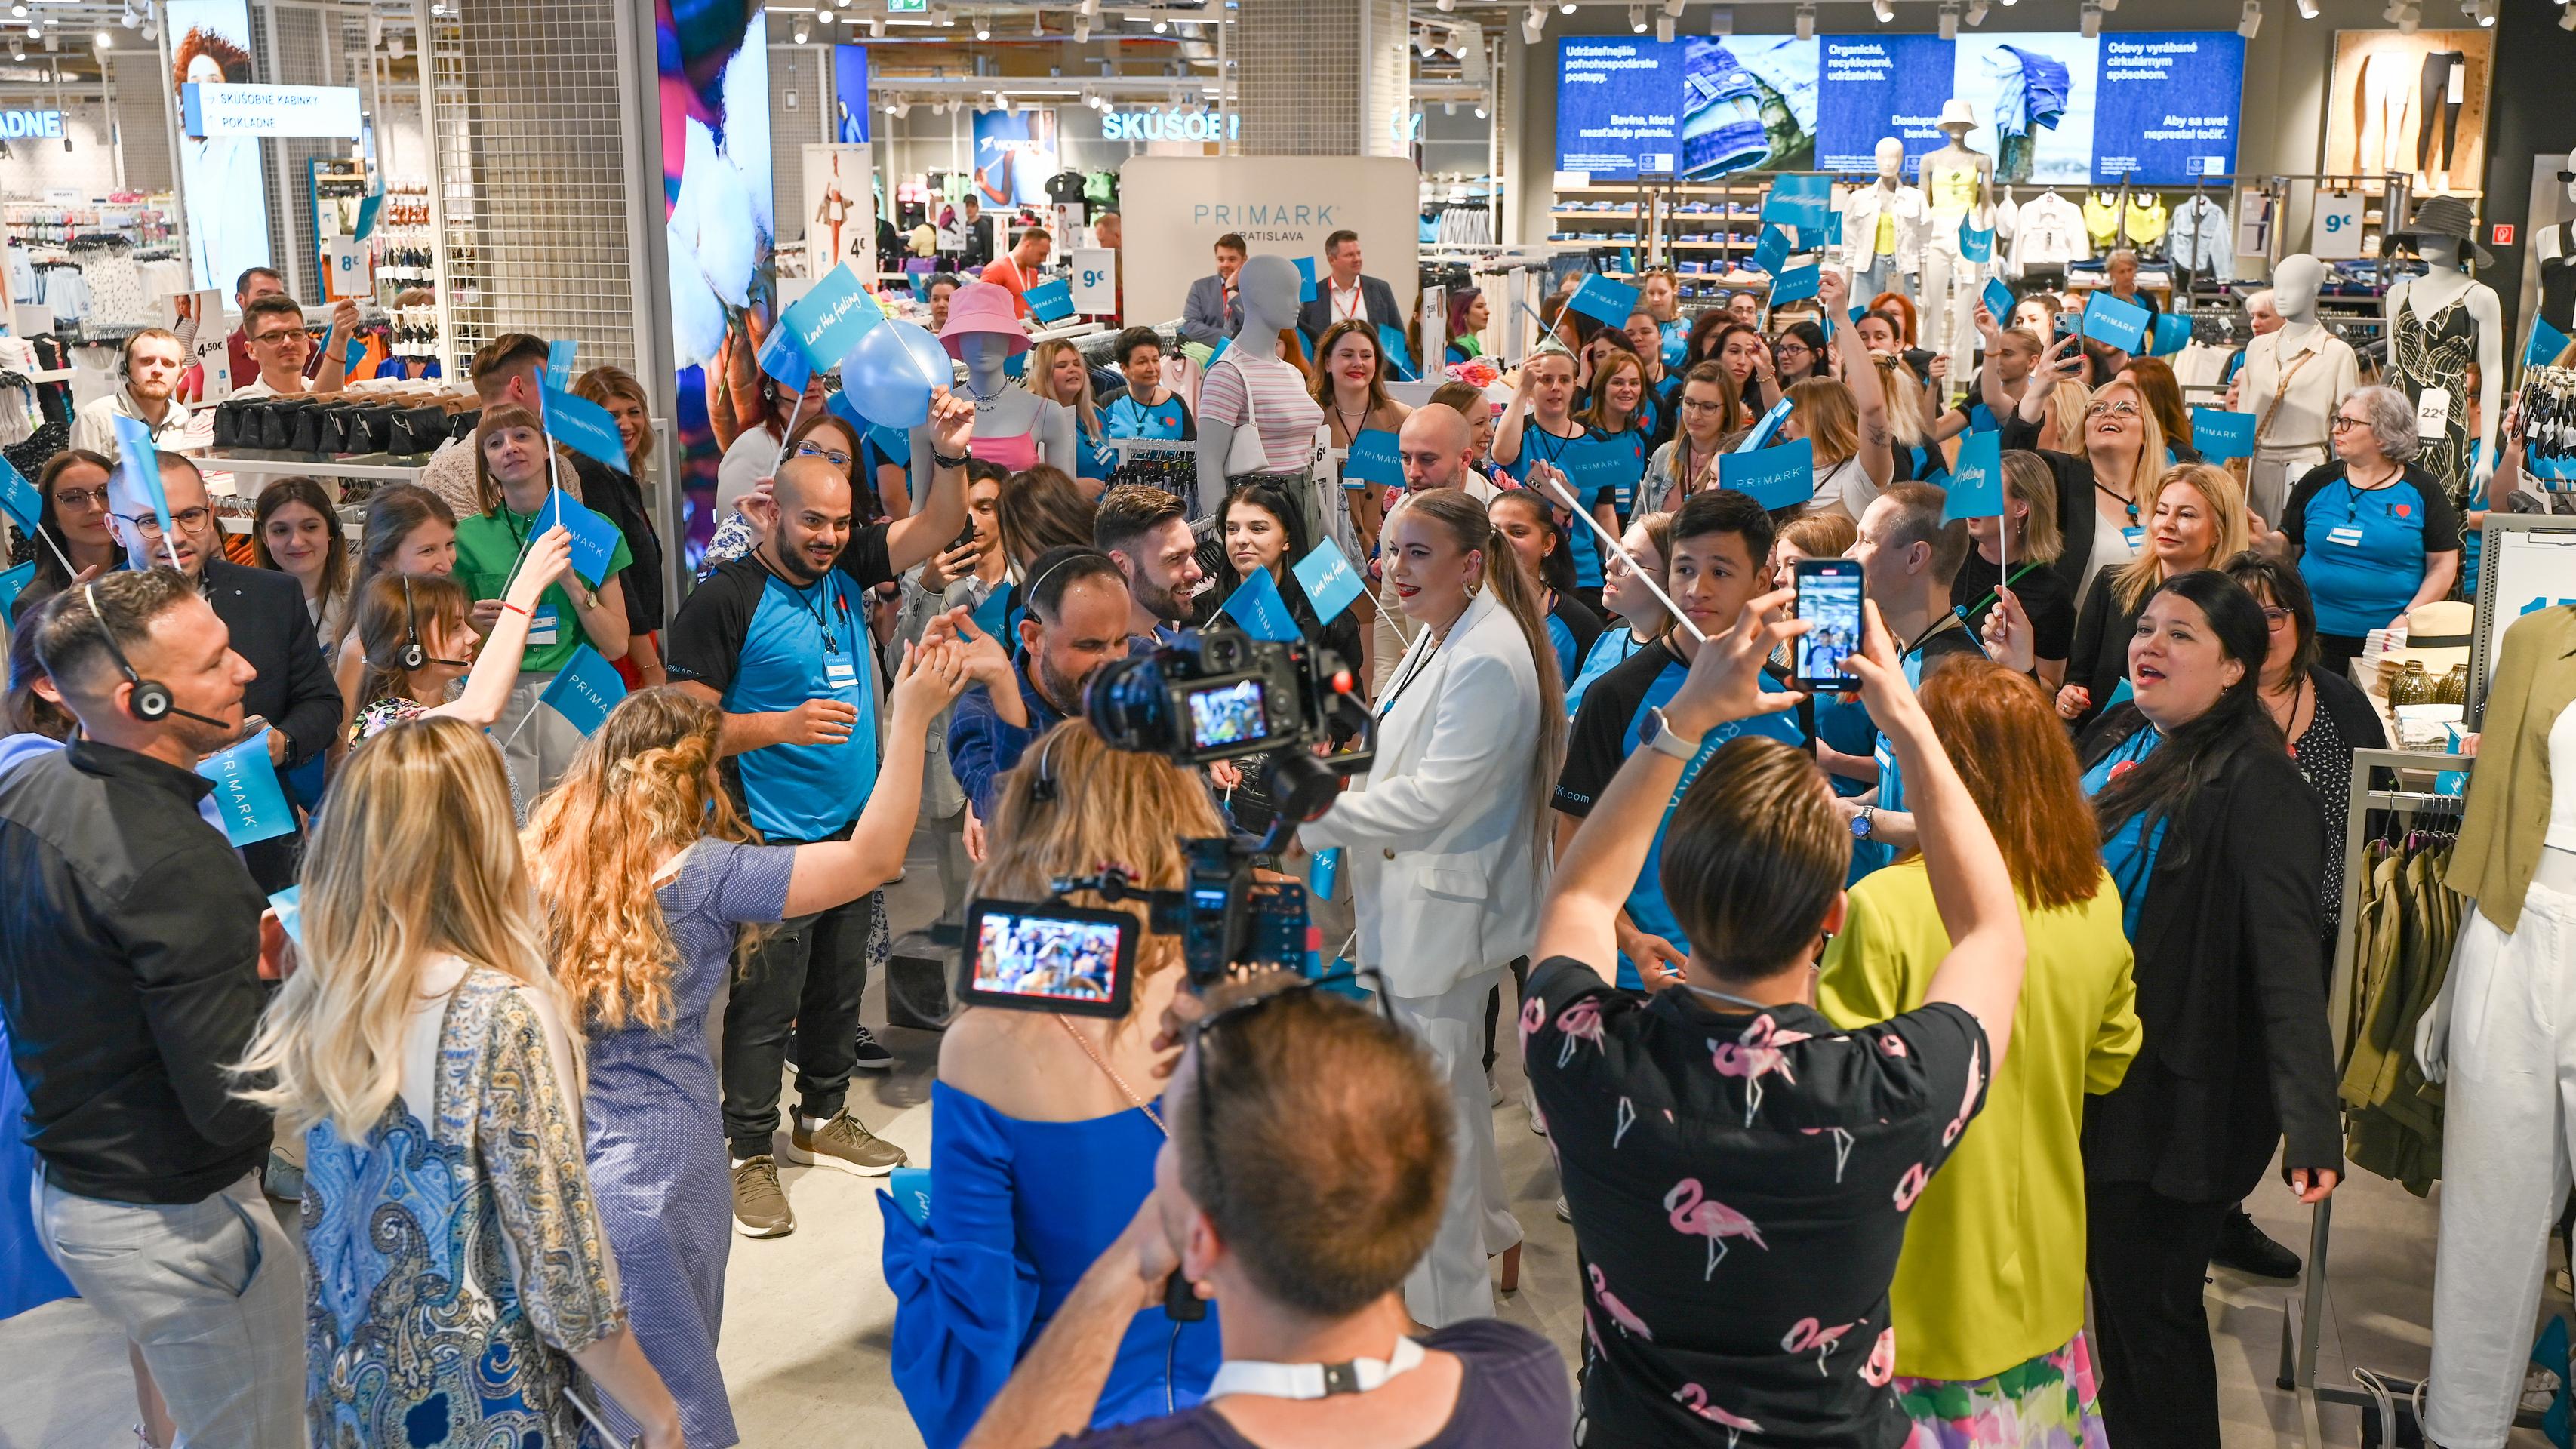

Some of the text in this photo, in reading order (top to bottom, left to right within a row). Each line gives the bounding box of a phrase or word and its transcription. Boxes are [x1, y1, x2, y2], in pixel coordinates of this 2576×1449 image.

[2108, 42, 2144, 55] Odevy
[2163, 115, 2229, 128] Aby sa svet
[1194, 205, 1334, 226] PRIMARK
[2326, 214, 2351, 232] 9€
[851, 238, 865, 258] 4€
[341, 255, 359, 271] 8€
[1083, 270, 1104, 287] 9€
[2094, 312, 2137, 333] PRIMARK
[803, 324, 824, 346] Love
[198, 341, 223, 358] 4.50€
[2421, 408, 2445, 418] 22€
[2196, 425, 2237, 439] PRIMARK
[1316, 447, 1326, 462] 6€
[1575, 460, 1620, 471] PRIMARK
[1736, 467, 1800, 488] PRIMARK
[1254, 597, 1279, 641] PRIMA
[568, 675, 608, 714] PRIMA
[223, 750, 257, 826] PRIMARK
